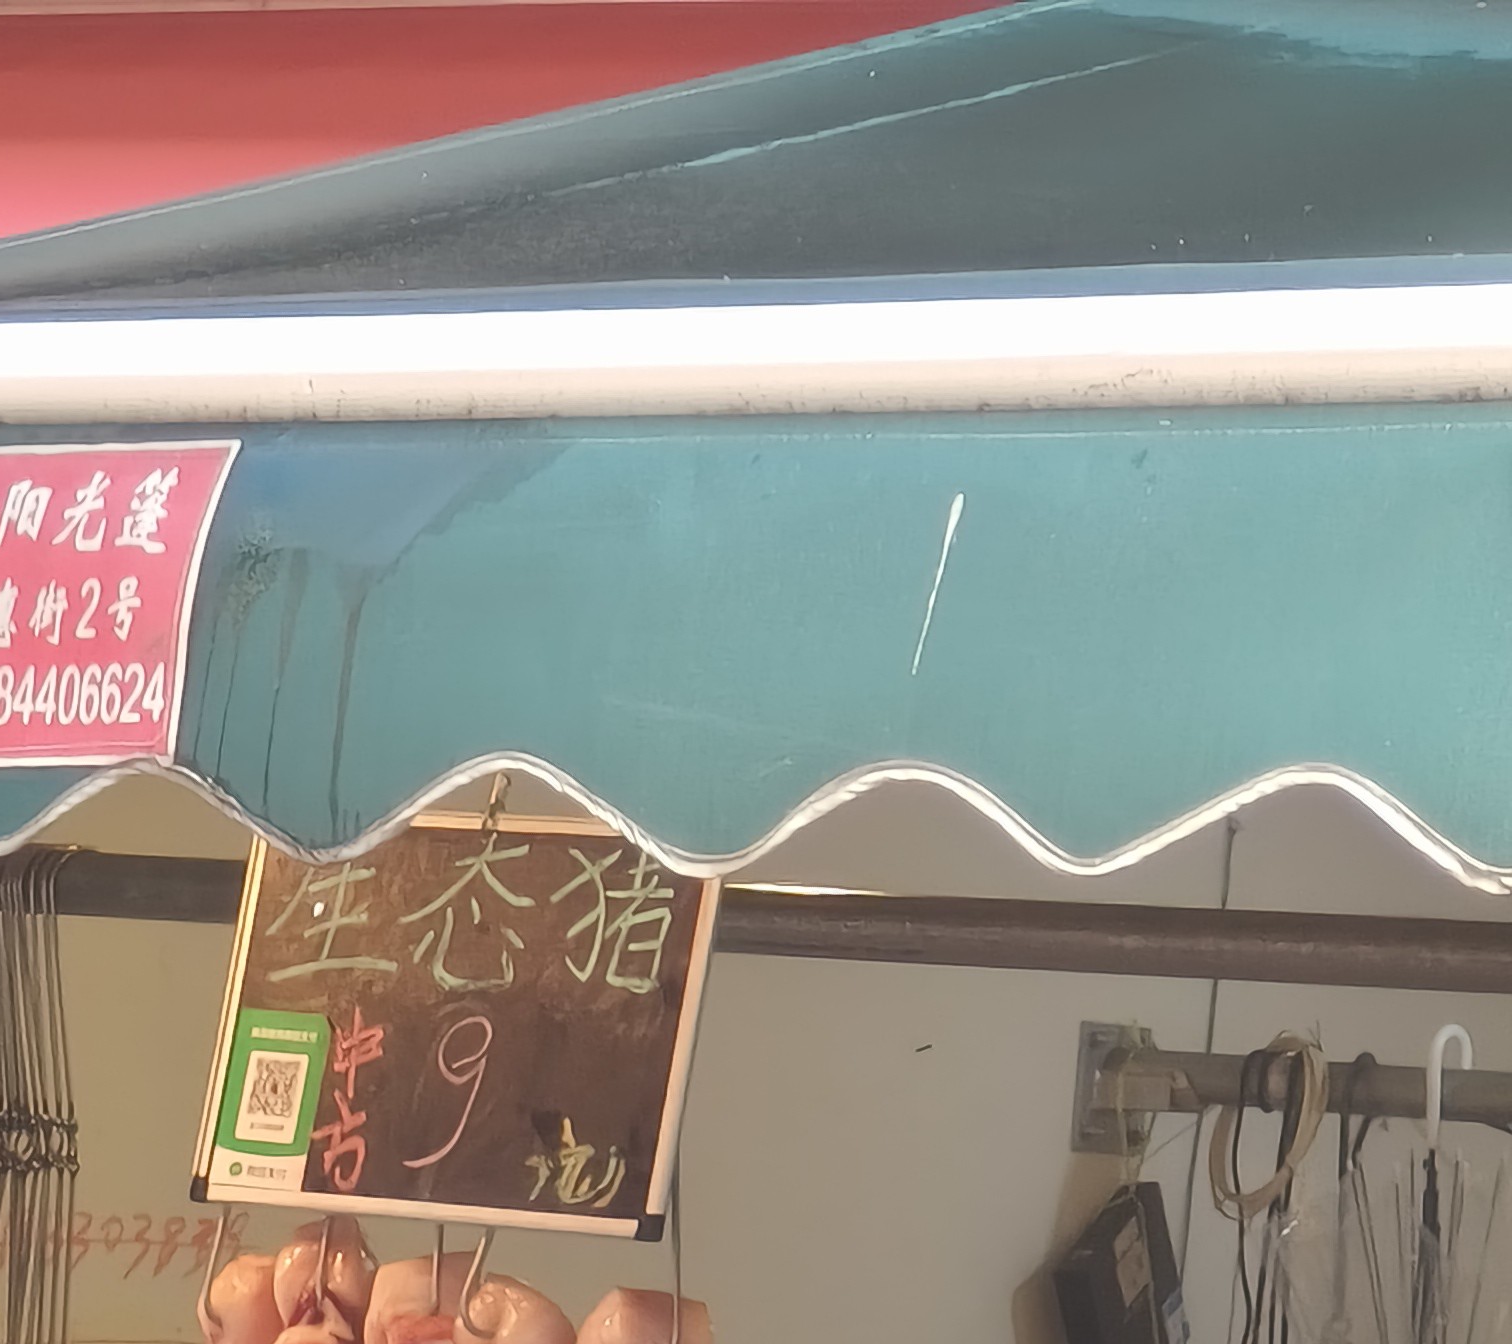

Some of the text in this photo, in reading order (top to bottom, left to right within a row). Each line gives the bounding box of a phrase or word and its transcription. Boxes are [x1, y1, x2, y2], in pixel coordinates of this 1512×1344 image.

[265, 833, 675, 994] 生态猪
[402, 1016, 493, 1169] 9
